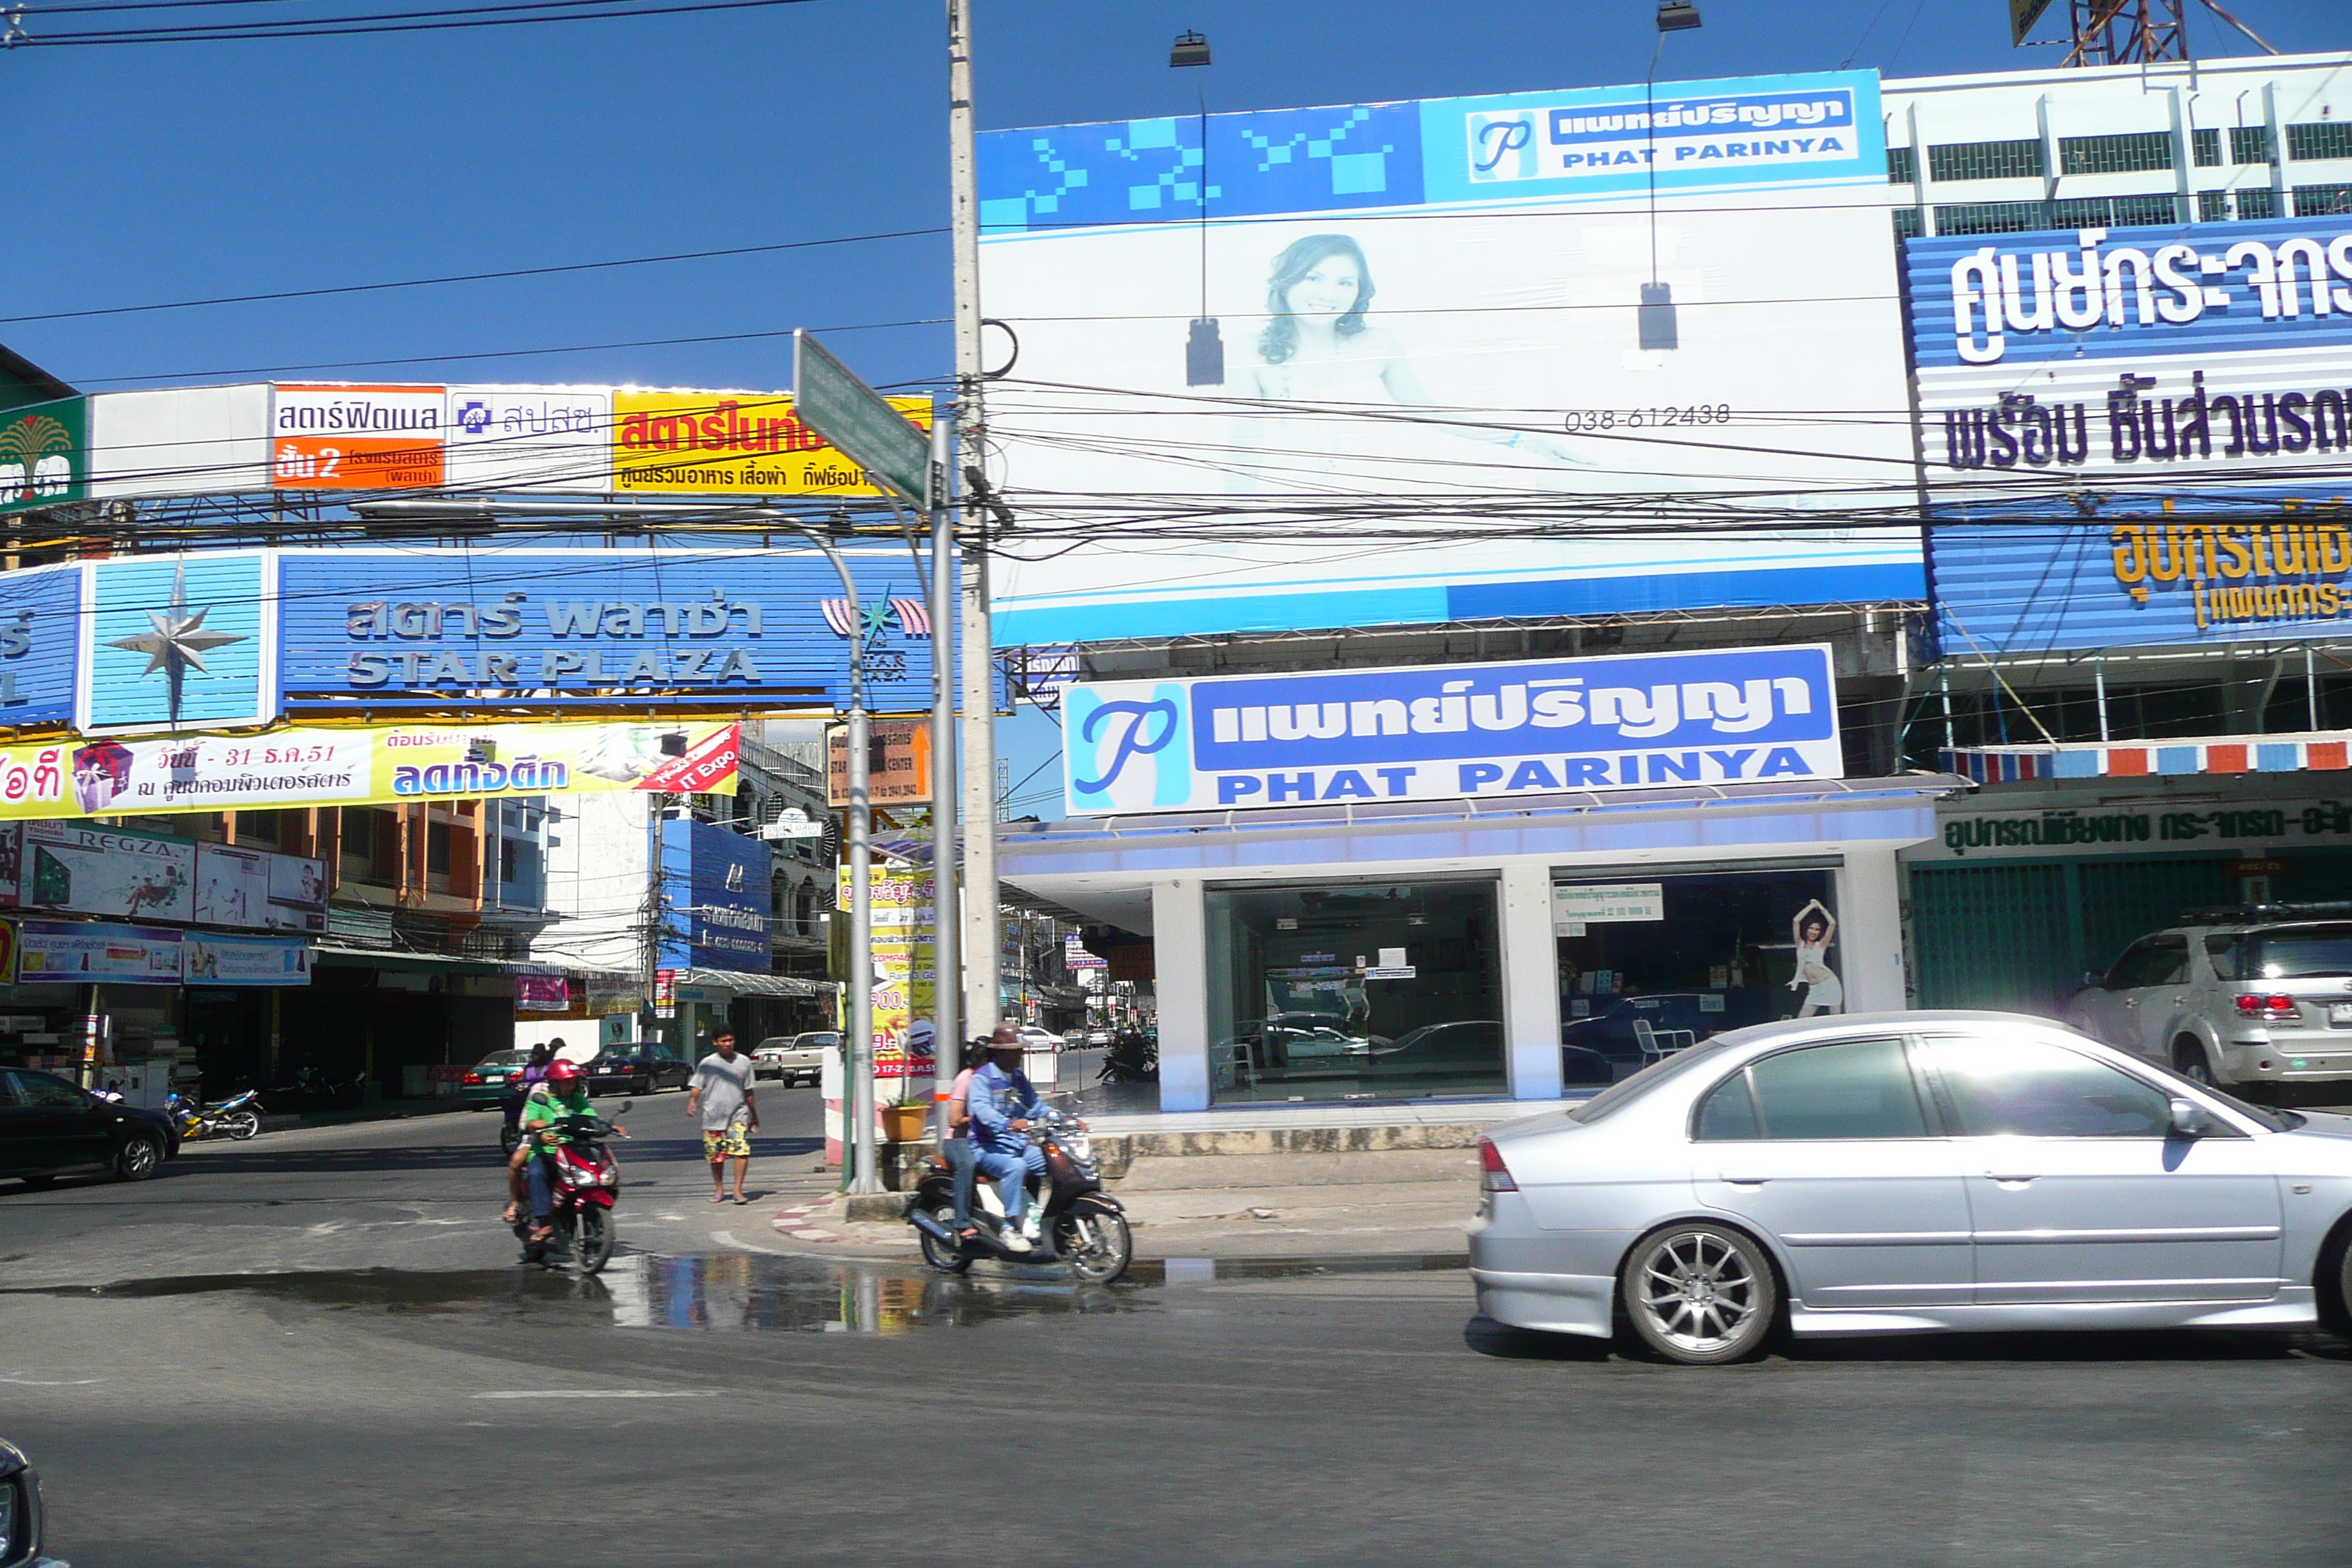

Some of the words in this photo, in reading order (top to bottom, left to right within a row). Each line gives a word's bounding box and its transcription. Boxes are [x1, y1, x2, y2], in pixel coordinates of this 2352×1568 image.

[1558, 99, 1842, 134] แพทย์ปริญญา
[1563, 148, 1658, 167] PHAT
[1675, 135, 1844, 160] PARINYA
[279, 402, 437, 429] สตาร์ฟิตเนส
[1565, 404, 1730, 431] 038-612438
[1945, 391, 2088, 466] พร้อม
[276, 444, 314, 478] ชั้น
[319, 448, 341, 478] 2
[620, 465, 734, 489] ศูนย์รวมอาหาร
[740, 461, 786, 486] เสื้อผ้า
[347, 591, 526, 640] สตาร์
[545, 589, 762, 640] พลาซ่า
[348, 650, 519, 685] STAR
[541, 649, 761, 684] PLAZA
[1214, 677, 1812, 742] แพทย์ปริญญา
[157, 740, 206, 769] วันนี้
[225, 747, 250, 765] 31
[393, 747, 568, 794] ลดทั้งตึก
[679, 772, 698, 790] IT
[696, 750, 736, 777] Expo
[1218, 767, 1417, 804] PHAT
[1458, 747, 1814, 794] PARINYA
